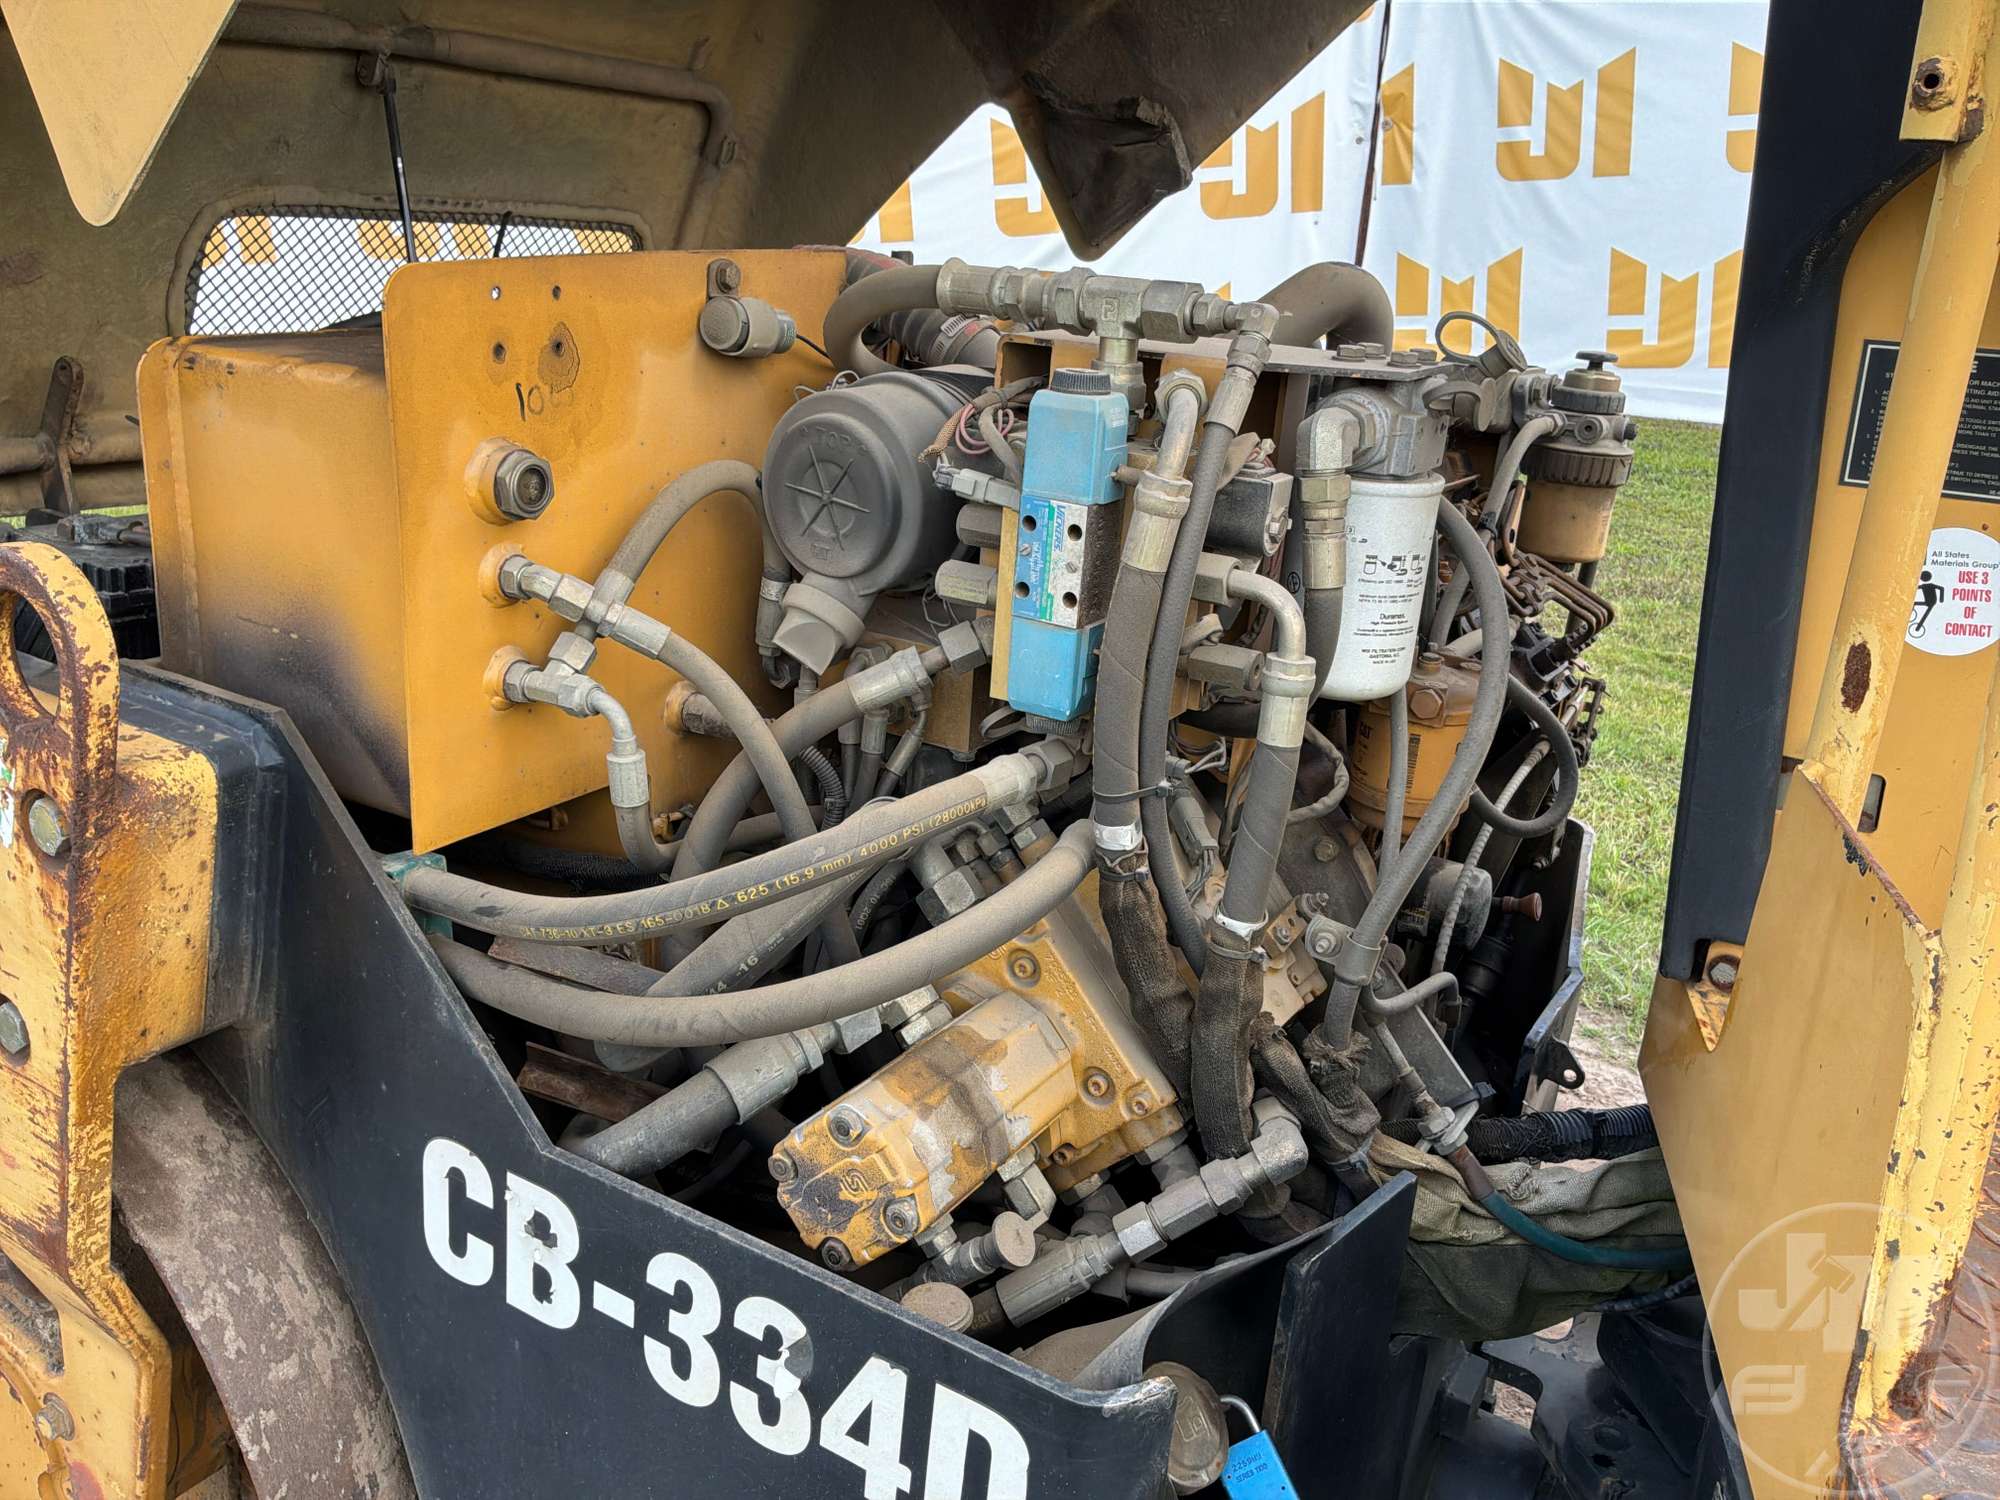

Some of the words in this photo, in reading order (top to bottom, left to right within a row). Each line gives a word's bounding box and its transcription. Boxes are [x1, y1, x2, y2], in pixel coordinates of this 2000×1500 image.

[1931, 550, 1943, 558] All
[1945, 551, 1970, 559] States
[1931, 559, 1969, 568] Materials
[1958, 570, 1979, 585] USE
[1981, 571, 1990, 585] 3
[1951, 587, 1992, 603] POINTS
[1963, 606, 1977, 620] OF
[1944, 622, 1993, 638] CONTACT
[616, 920, 636, 934] ES
[734, 884, 769, 906] .625
[775, 865, 816, 891] (15.9
[820, 854, 853, 874] mm)
[859, 834, 898, 858] 4000
[902, 819, 925, 840] PSI
[421, 1136, 1031, 1500] CB-334D
